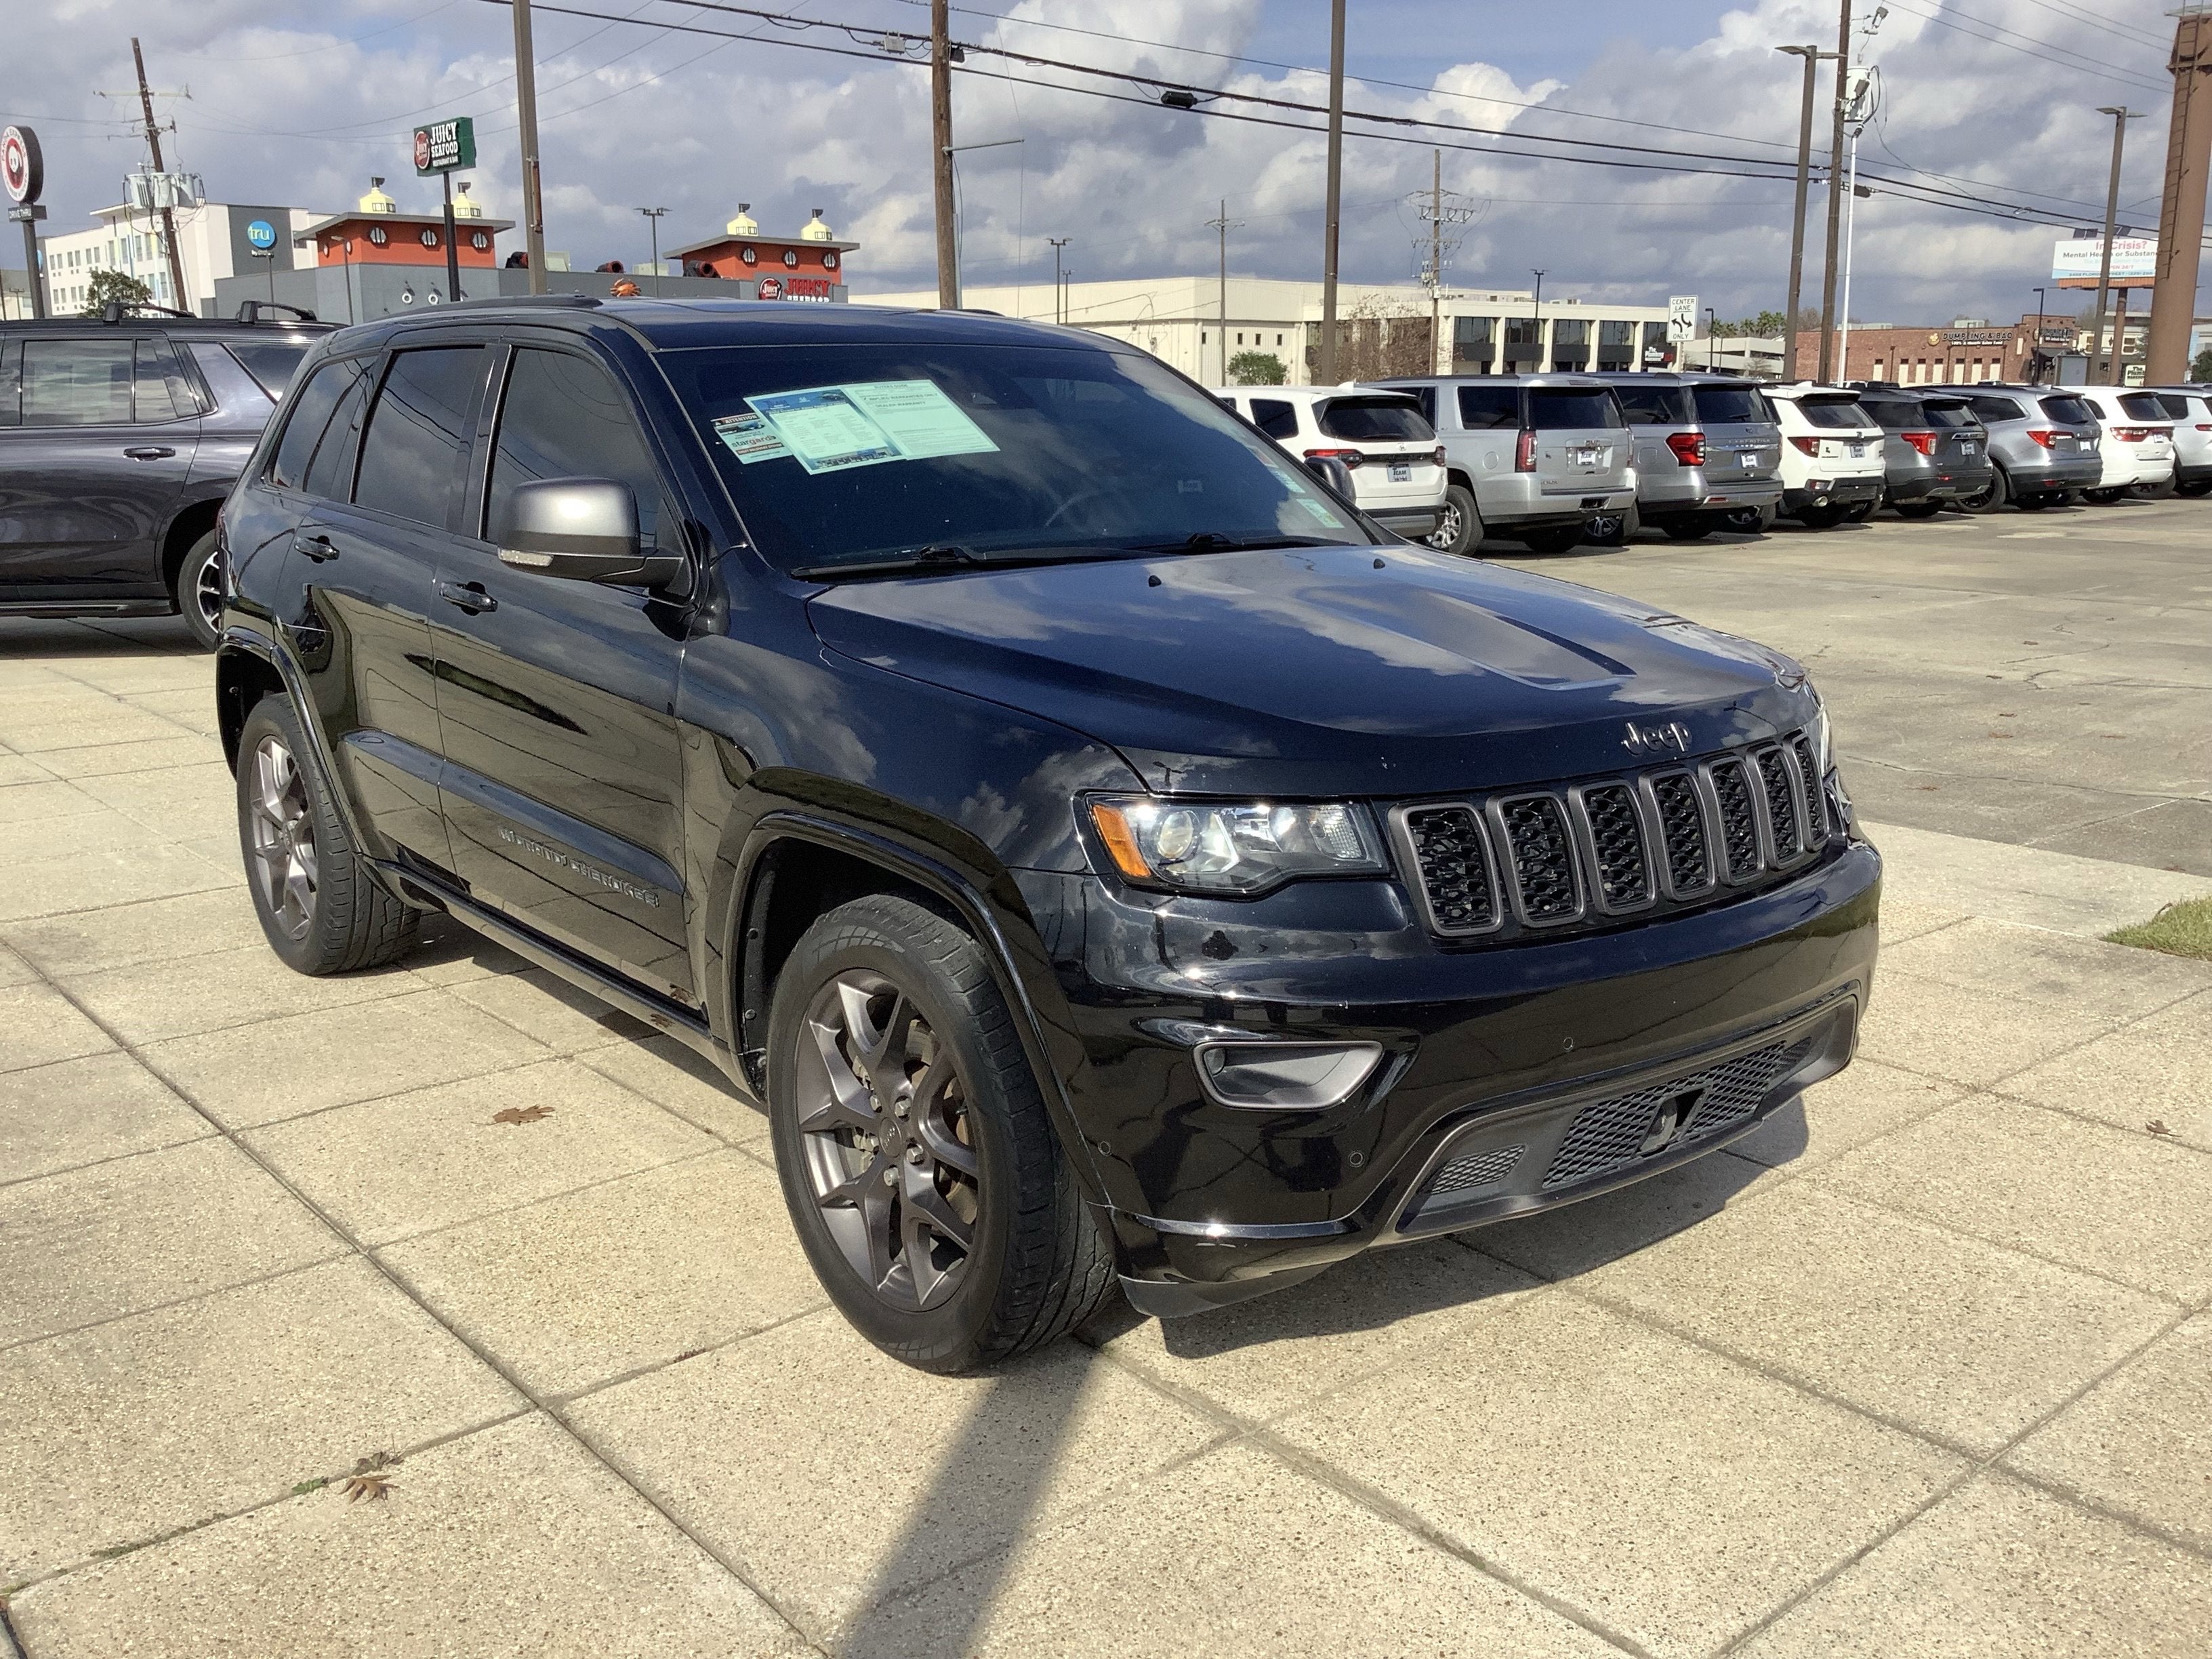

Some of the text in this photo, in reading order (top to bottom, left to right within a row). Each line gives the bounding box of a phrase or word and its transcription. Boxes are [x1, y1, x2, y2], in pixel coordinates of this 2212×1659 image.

[430, 121, 457, 145] JUICY
[430, 140, 459, 158] SEAFOOD
[248, 226, 270, 241] tru
[2111, 240, 2148, 250] Crisis?
[783, 277, 831, 298] JUICY
[725, 413, 758, 424] ATTENTION
[1620, 720, 1693, 758] Jeep
